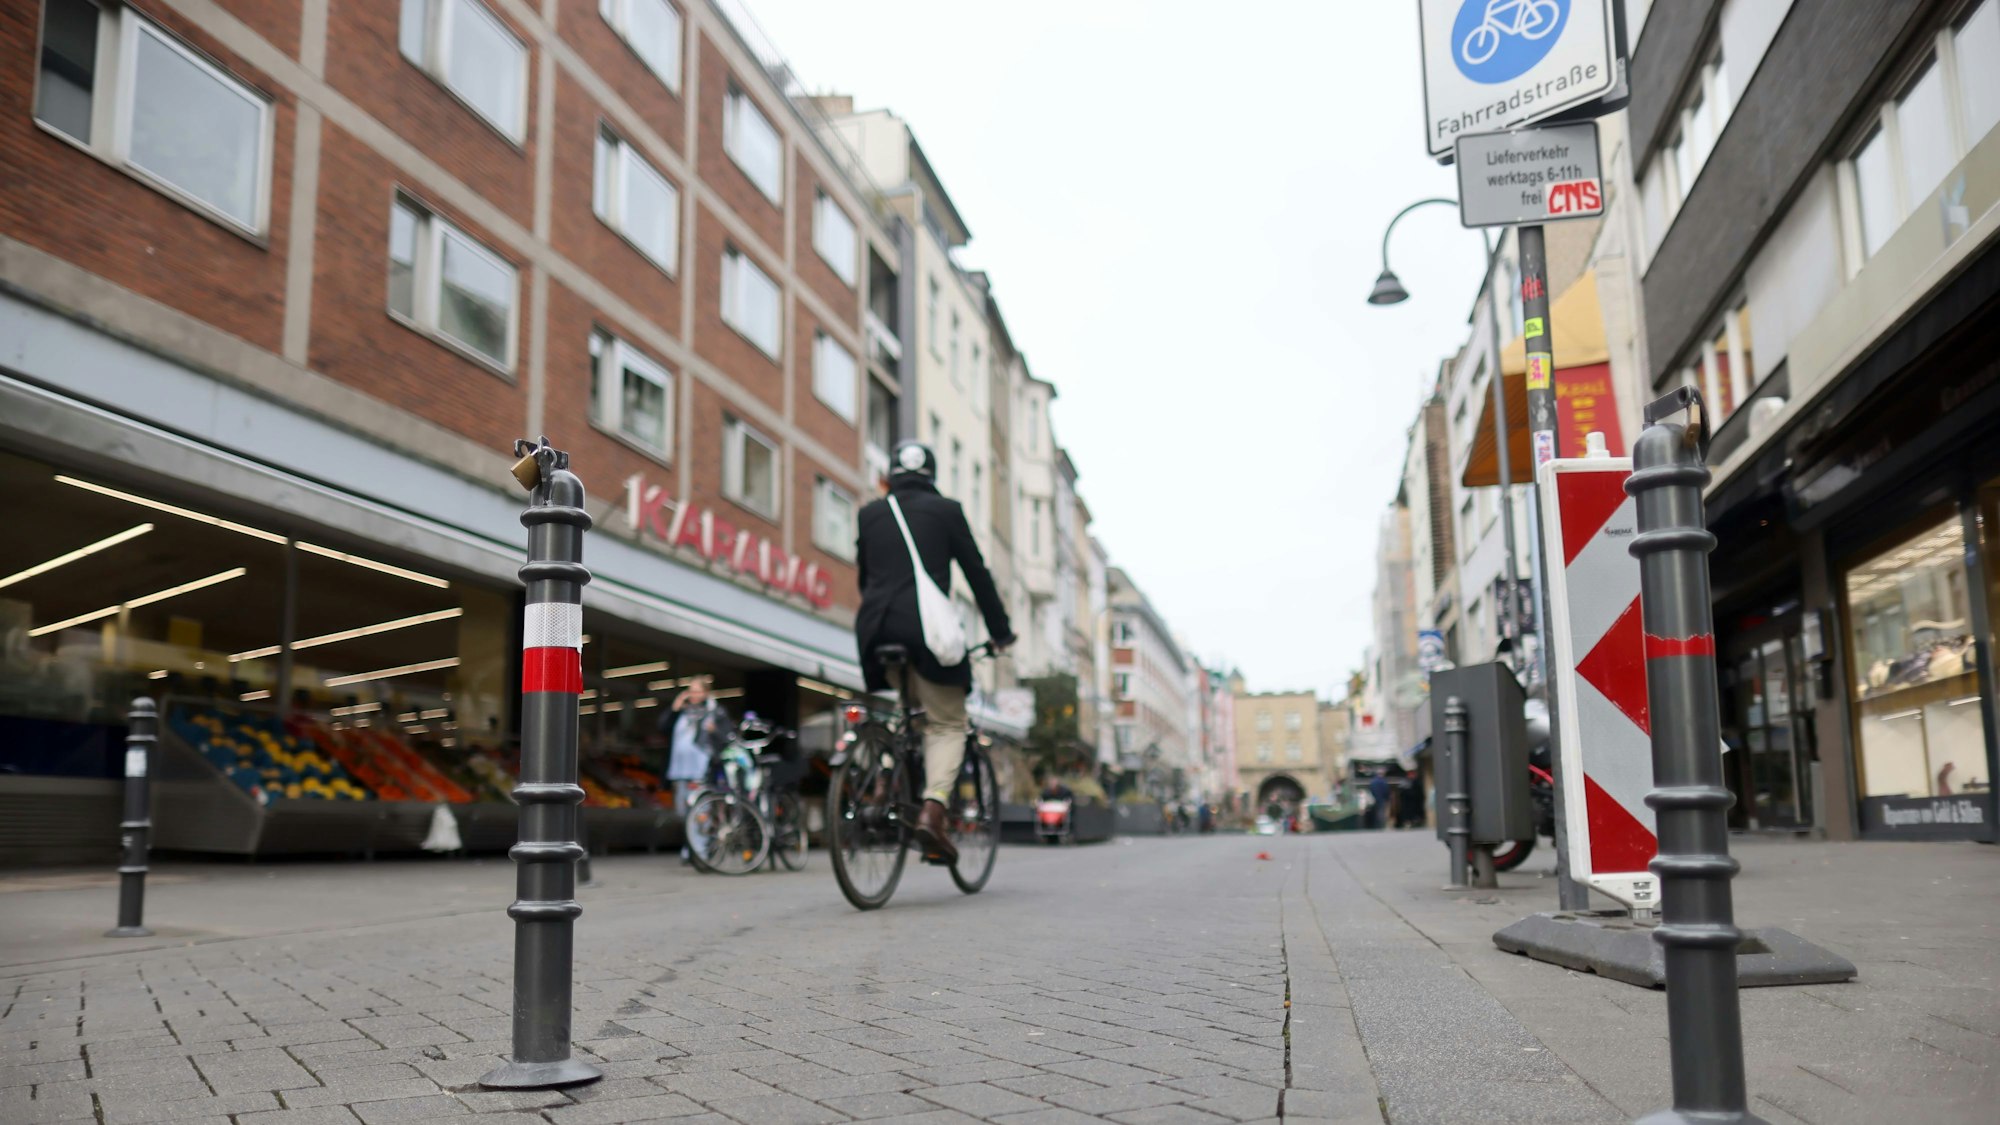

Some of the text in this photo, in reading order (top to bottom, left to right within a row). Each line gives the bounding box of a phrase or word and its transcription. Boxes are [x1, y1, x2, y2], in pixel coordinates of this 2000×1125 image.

[1437, 64, 1598, 139] Fahrradstraße
[1486, 145, 1569, 166] Lieferverkehr
[1486, 165, 1583, 187] werktags 6-11h
[1521, 191, 1543, 206] frei
[1548, 181, 1602, 215] CNS
